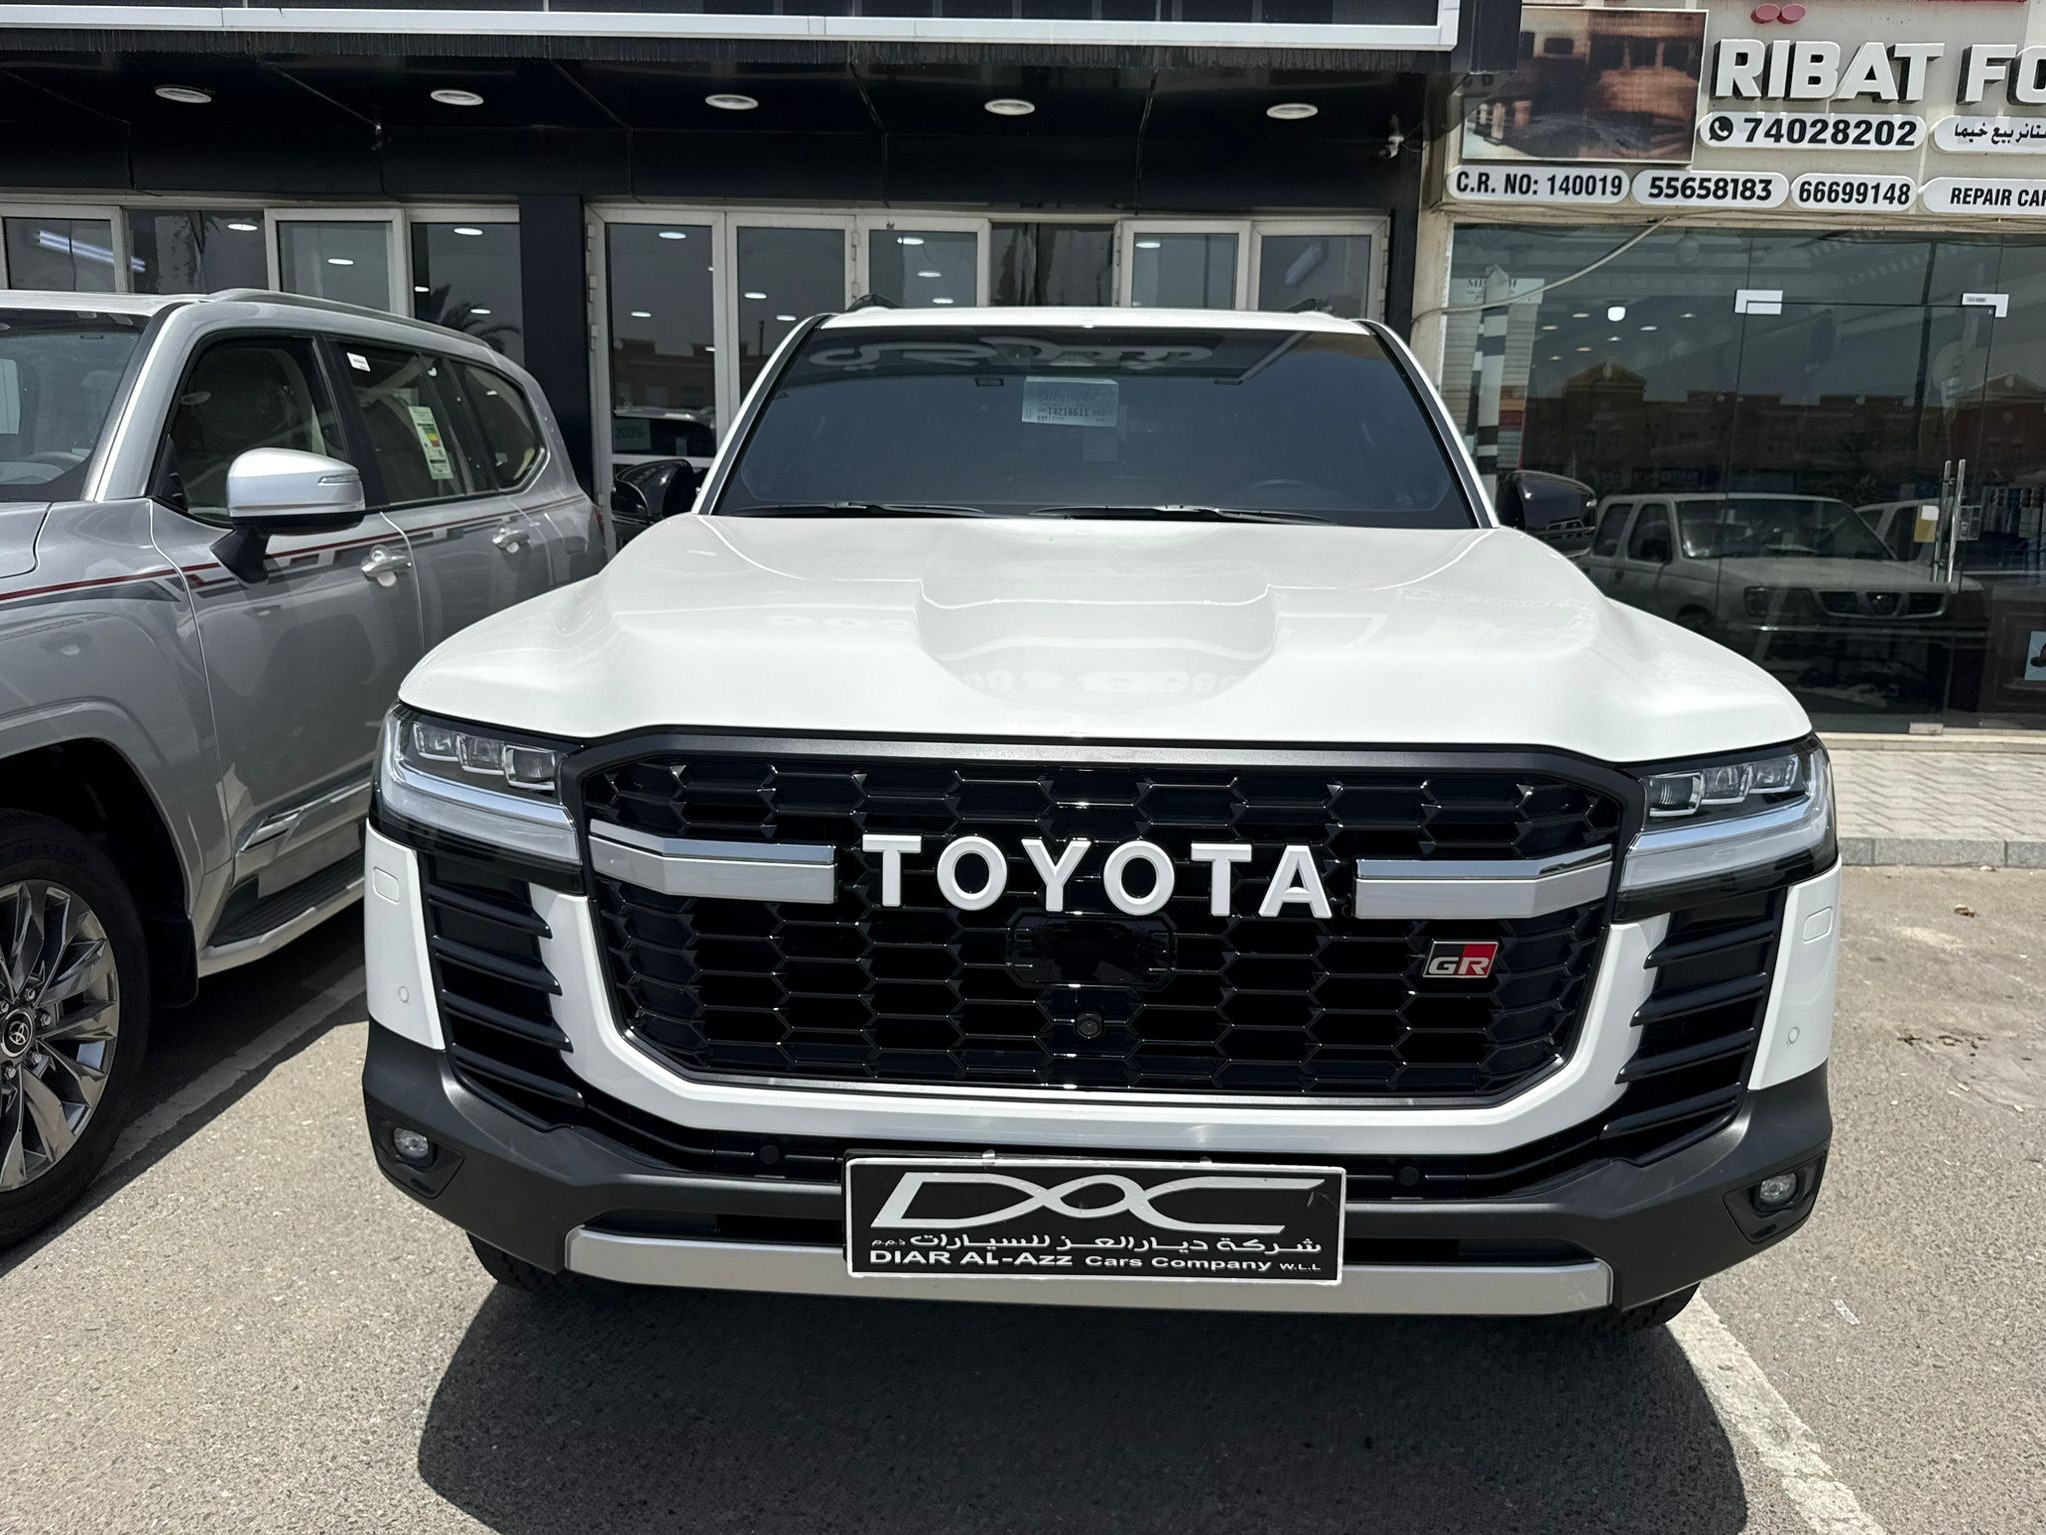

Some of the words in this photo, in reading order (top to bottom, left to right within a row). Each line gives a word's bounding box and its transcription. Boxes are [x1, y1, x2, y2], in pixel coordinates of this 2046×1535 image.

[1711, 39, 1945, 101] RIBAT
[1743, 118, 1917, 146] 74028202
[1456, 171, 1495, 193] C.R.
[1504, 174, 1538, 195] NO:
[1547, 175, 1622, 196] 140019
[1648, 176, 1773, 200] 55658183
[1799, 180, 1911, 205] 66699148
[1950, 187, 2013, 206] REPAIR
[861, 834, 1333, 919] TOYOTA
[1428, 956, 1489, 975] GR
[910, 1233, 1051, 1250] للسيارات
[1216, 1237, 1322, 1255] شركة
[870, 1250, 952, 1264] DIAR
[1085, 1255, 1143, 1267] Cars
[1151, 1257, 1272, 1271] Company
